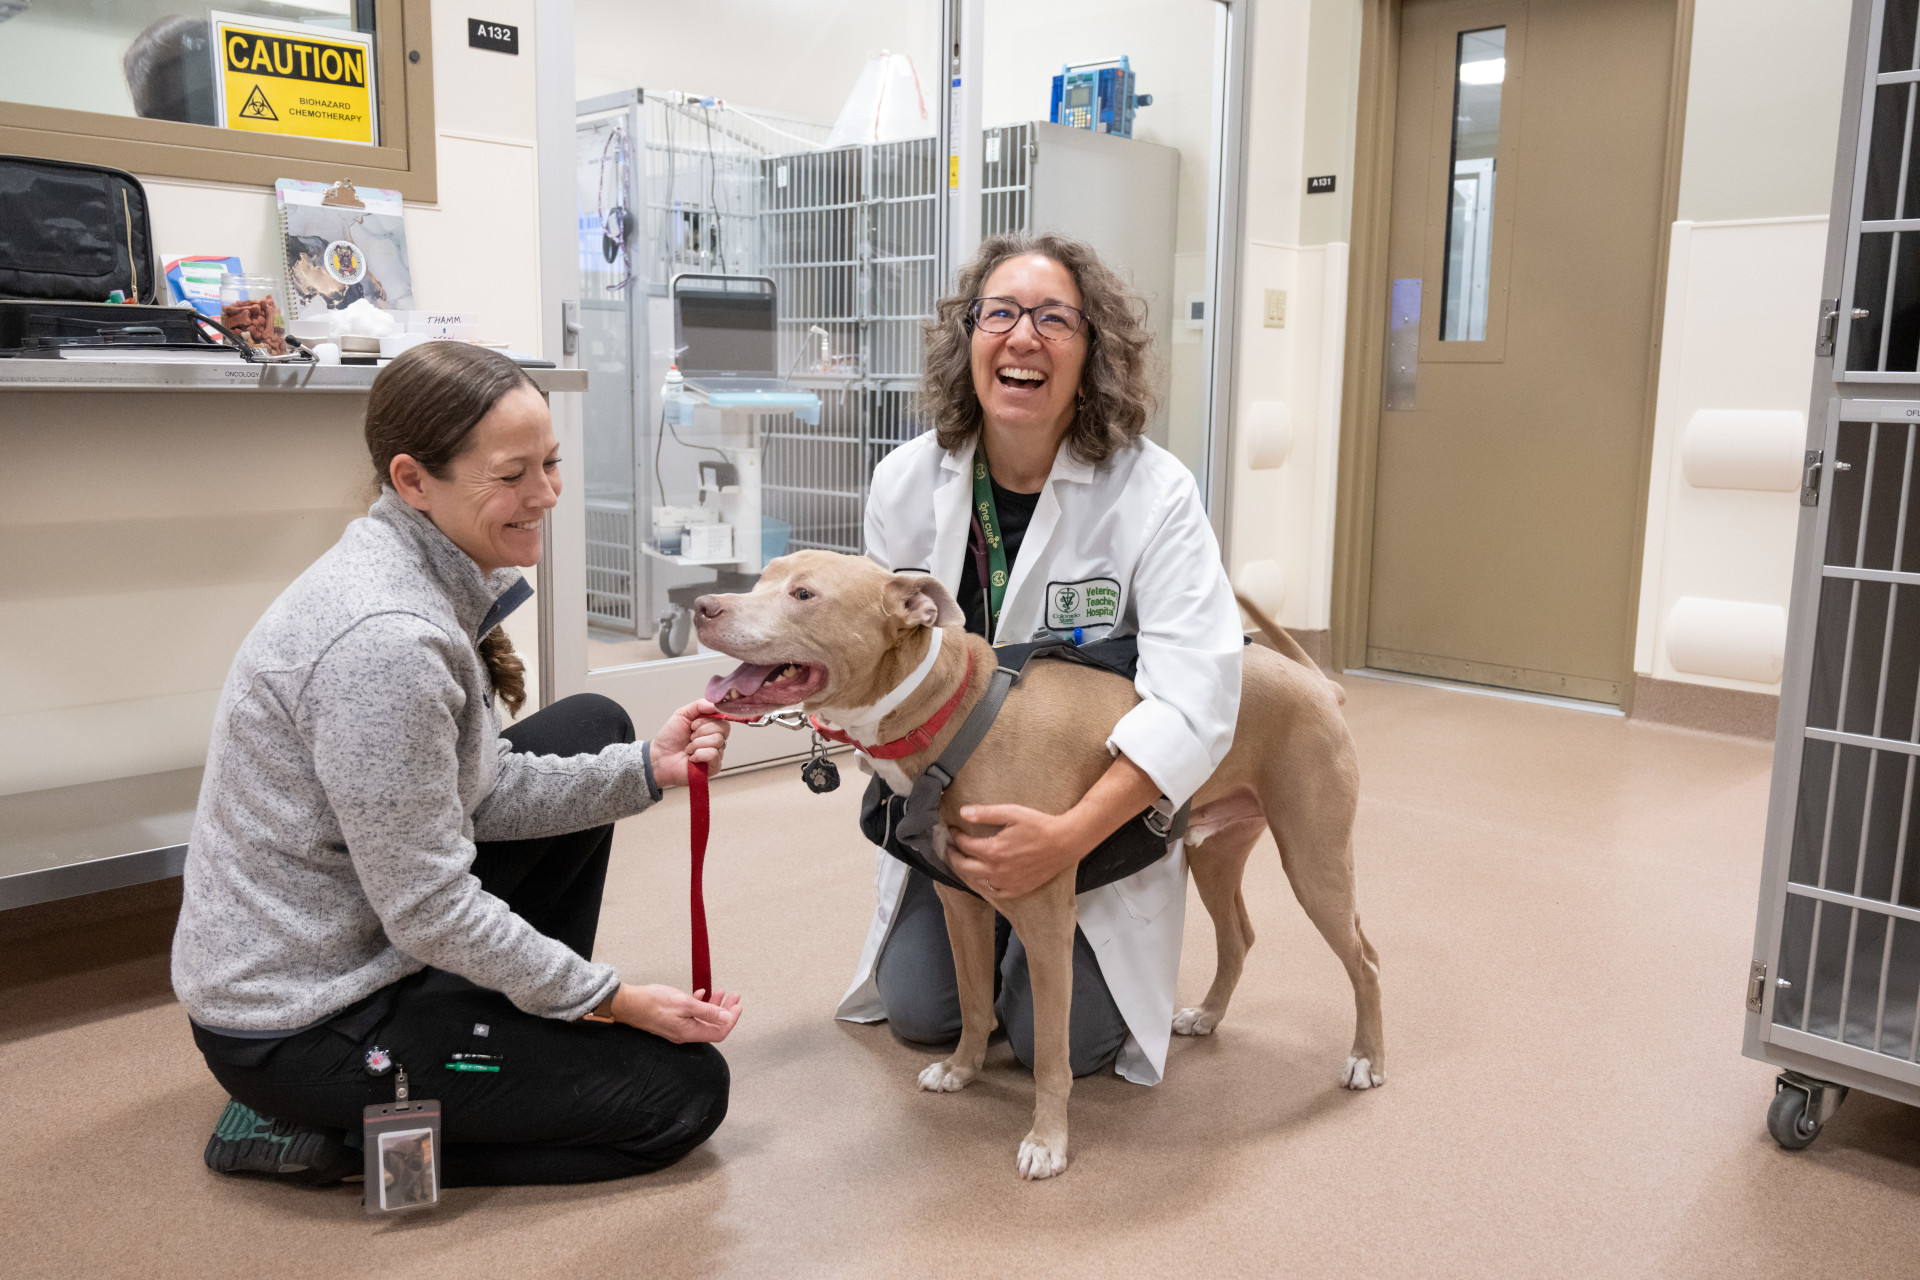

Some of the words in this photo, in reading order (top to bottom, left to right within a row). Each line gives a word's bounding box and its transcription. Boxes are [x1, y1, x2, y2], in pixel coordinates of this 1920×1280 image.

[477, 24, 511, 42] A132
[228, 35, 363, 84] CAUTION
[299, 97, 351, 110] BIOHAZARD
[288, 108, 362, 123] CHEMOTHERAPY
[1312, 177, 1331, 187] A131
[427, 316, 462, 324] THAMM
[980, 502, 990, 521] one
[984, 523, 995, 544] cure
[1086, 596, 1116, 610] Teaching
[1086, 606, 1114, 618] Hospital
